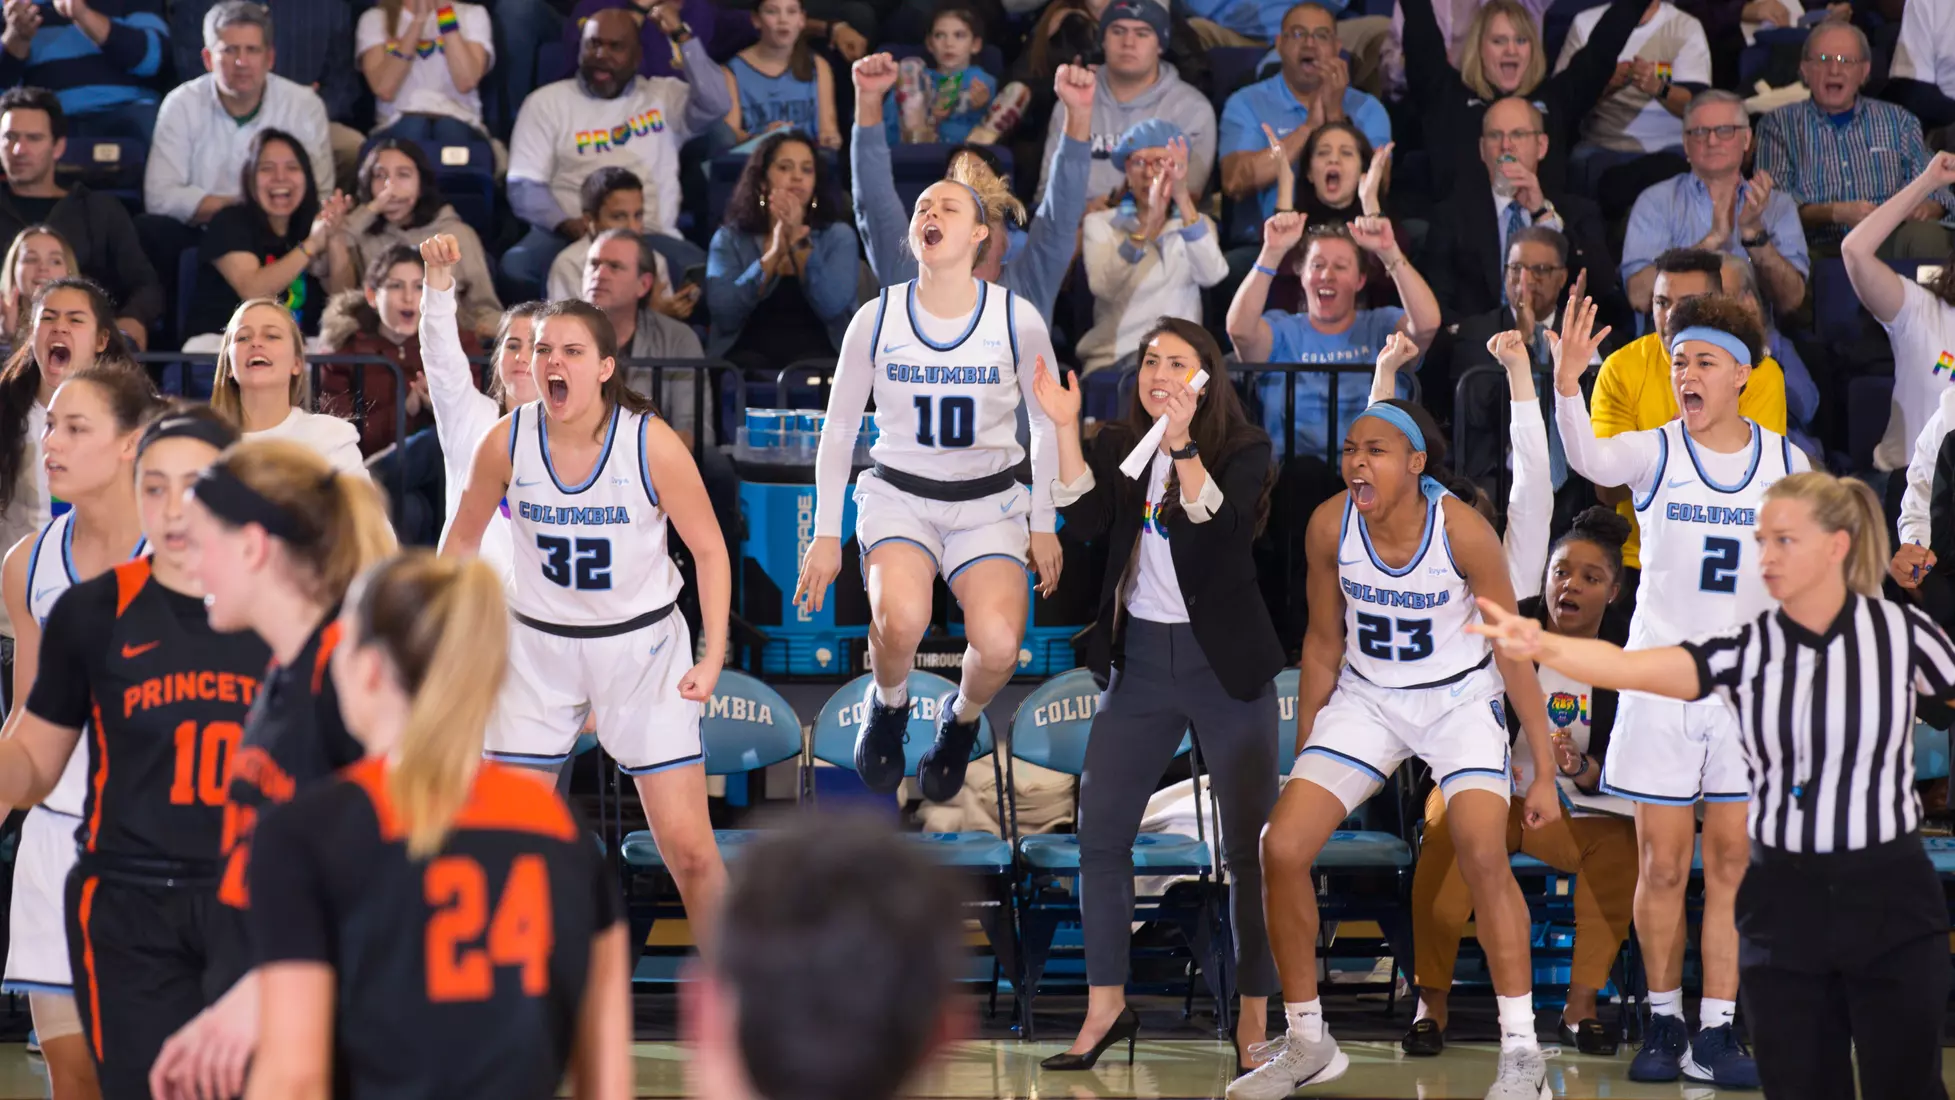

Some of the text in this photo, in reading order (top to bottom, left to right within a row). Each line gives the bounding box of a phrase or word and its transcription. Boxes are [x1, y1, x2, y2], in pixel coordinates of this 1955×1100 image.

[887, 363, 1001, 384] COLUMBIA
[1301, 344, 1370, 363] COLUMBIA
[913, 394, 976, 449] 10
[519, 500, 631, 525] COLUMBIA
[536, 533, 612, 590] 32
[1698, 535, 1742, 595] 2
[1341, 576, 1450, 609] COLUMBIA
[1355, 610, 1435, 662] 23
[123, 670, 263, 718] PRINCET
[170, 720, 244, 806] 10
[424, 853, 555, 1003] 24
